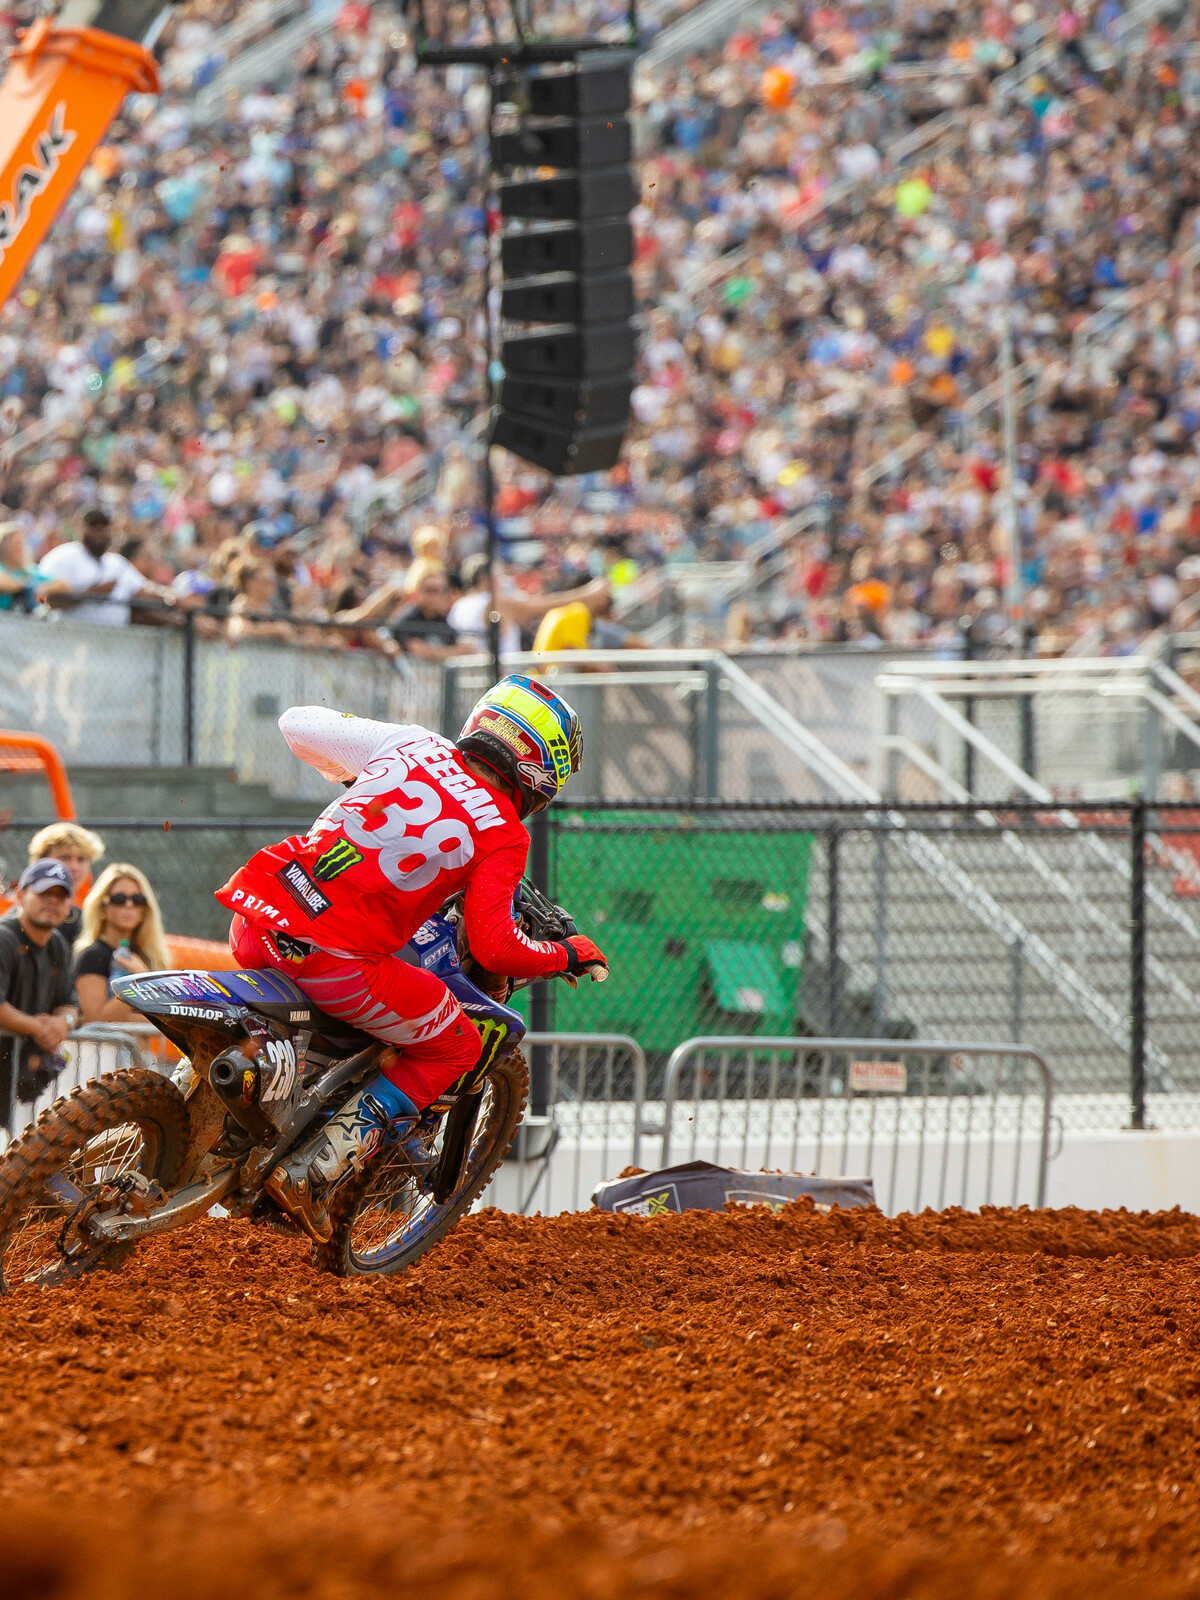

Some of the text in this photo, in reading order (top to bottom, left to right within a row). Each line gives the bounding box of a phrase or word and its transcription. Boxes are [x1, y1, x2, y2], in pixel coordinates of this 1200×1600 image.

[340, 757, 475, 892] 238
[231, 889, 290, 928] PRIME
[285, 864, 327, 912] YAMALUBE
[169, 1005, 223, 1020] DUNLOP
[289, 1010, 311, 1021] YAMAHA
[411, 991, 457, 1039] THOR
[262, 1039, 296, 1102] 238
